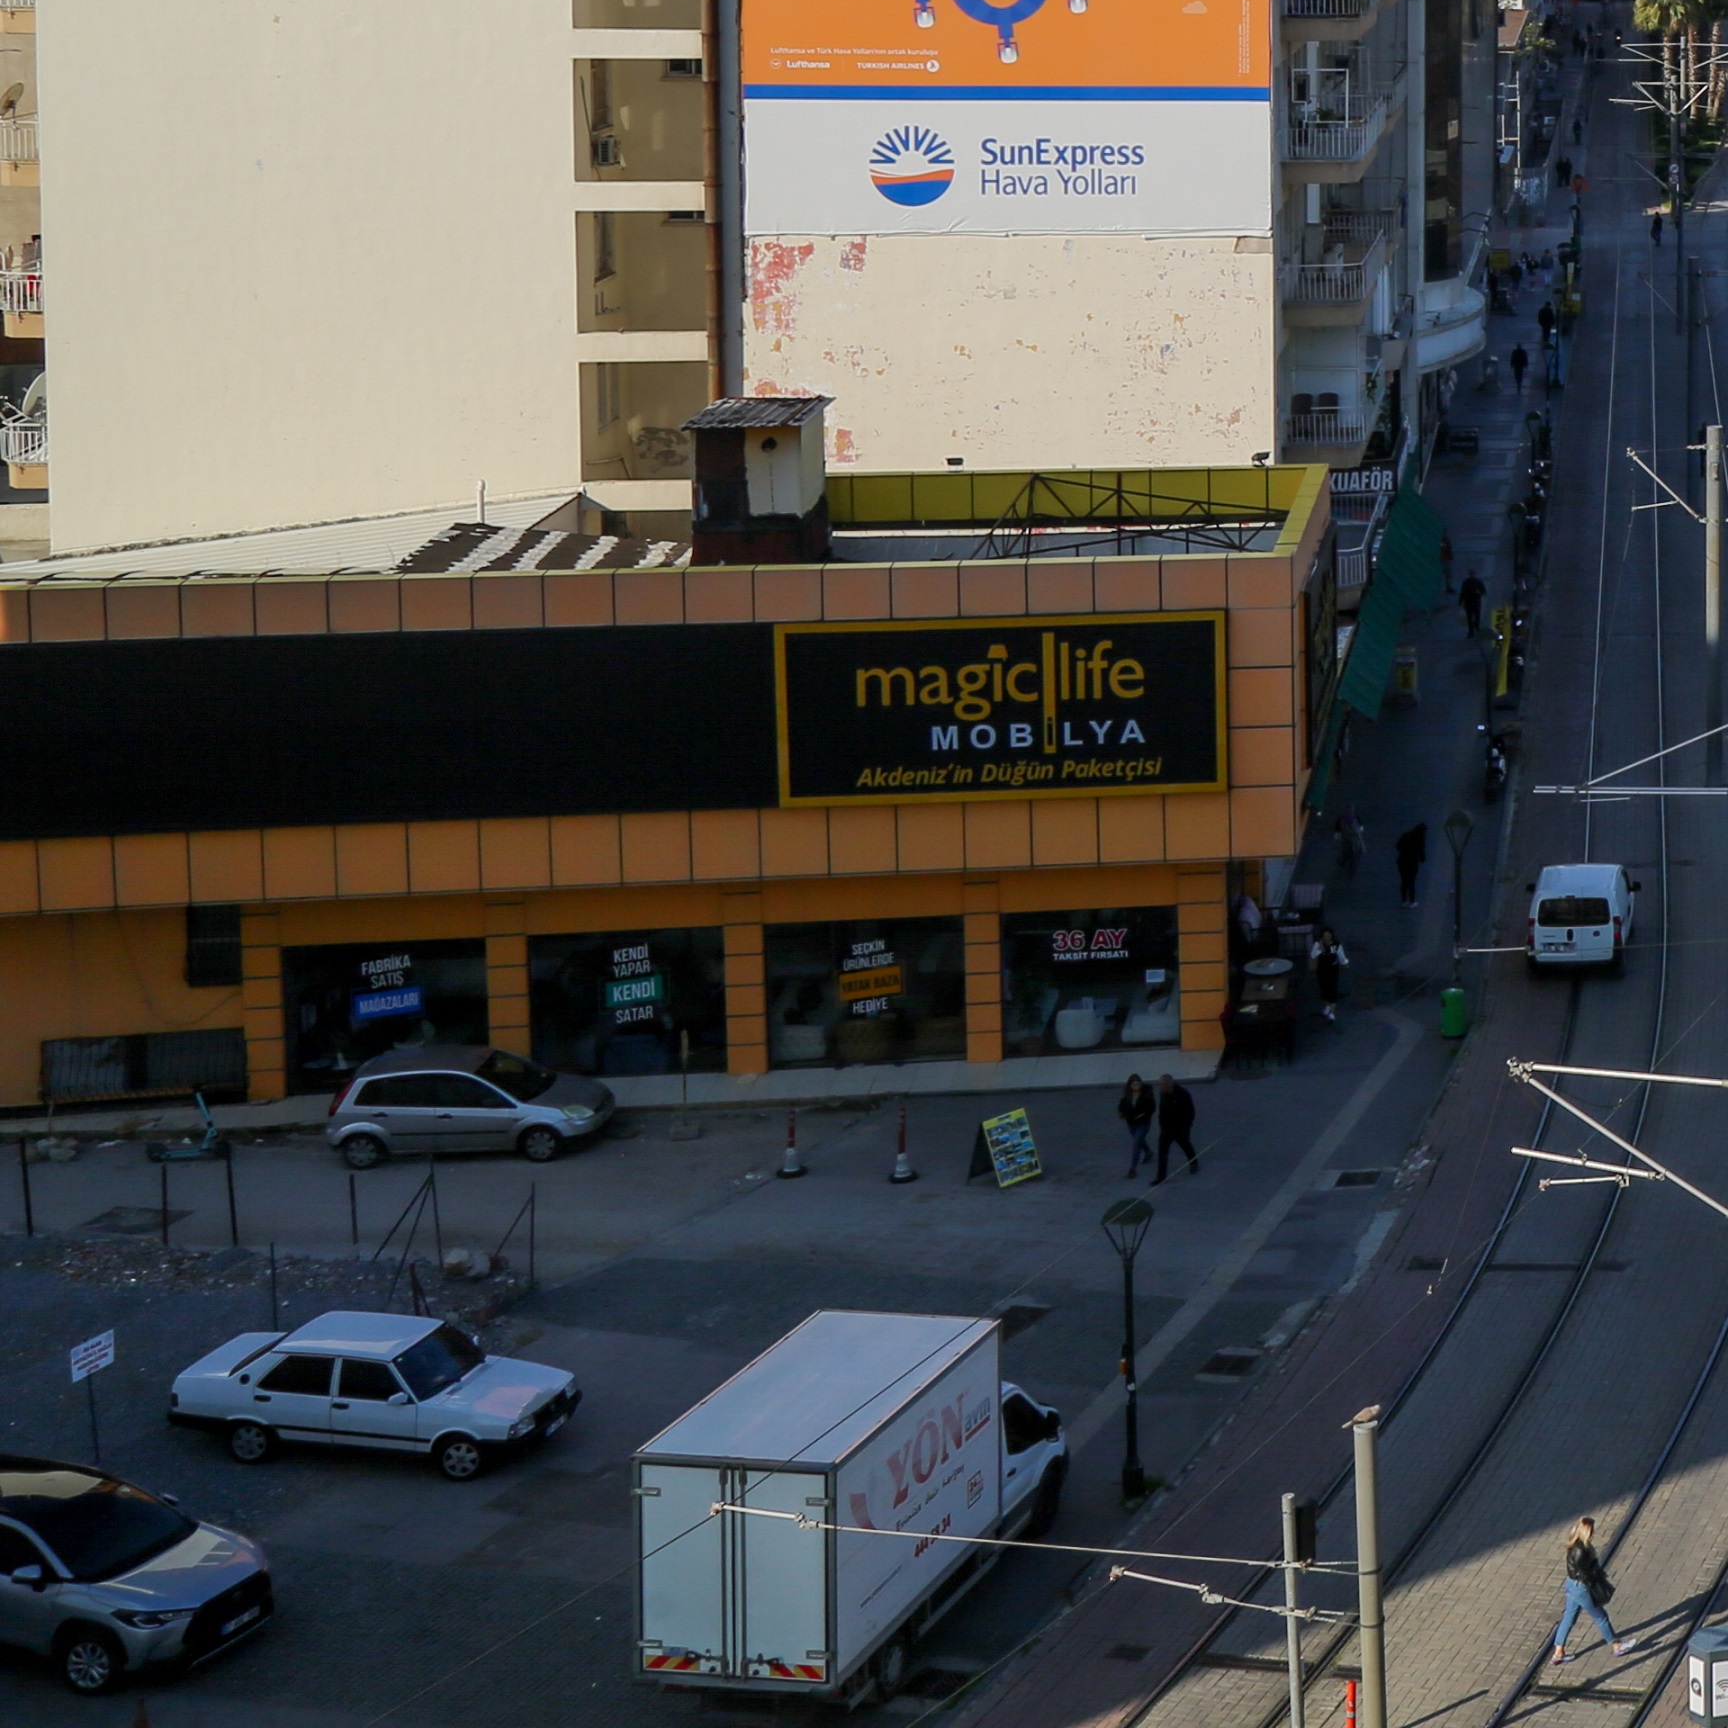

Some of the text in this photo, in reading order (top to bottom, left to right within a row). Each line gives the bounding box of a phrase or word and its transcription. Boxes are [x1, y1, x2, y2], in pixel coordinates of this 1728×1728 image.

[786, 60, 830, 69] Lufthansa
[891, 62, 924, 70] AIRLINES
[980, 138, 1145, 172] SunExpress
[980, 168, 1136, 195] Hava Yolları
[1329, 466, 1393, 491] KUAFÖR
[855, 756, 1162, 788] Akdeniz'in Düğün Paketçisi
[852, 939, 885, 956] SEÇKİN
[1053, 928, 1127, 951] 36 AY
[613, 943, 649, 964] KENDİ
[843, 952, 895, 971] ÜRÜNLERDE
[1053, 950, 1128, 961] TAKSİT FIRSATI
[361, 954, 411, 976] FABRİKA
[613, 960, 651, 978] YAPAR
[371, 971, 404, 989] SATIŞ
[613, 981, 656, 1002] KENDİ
[359, 991, 419, 1015] MAĞAZALARI
[852, 996, 889, 1014] HEDİYE
[616, 1005, 653, 1024] SATAR
[886, 1389, 990, 1509] YÖN avm
